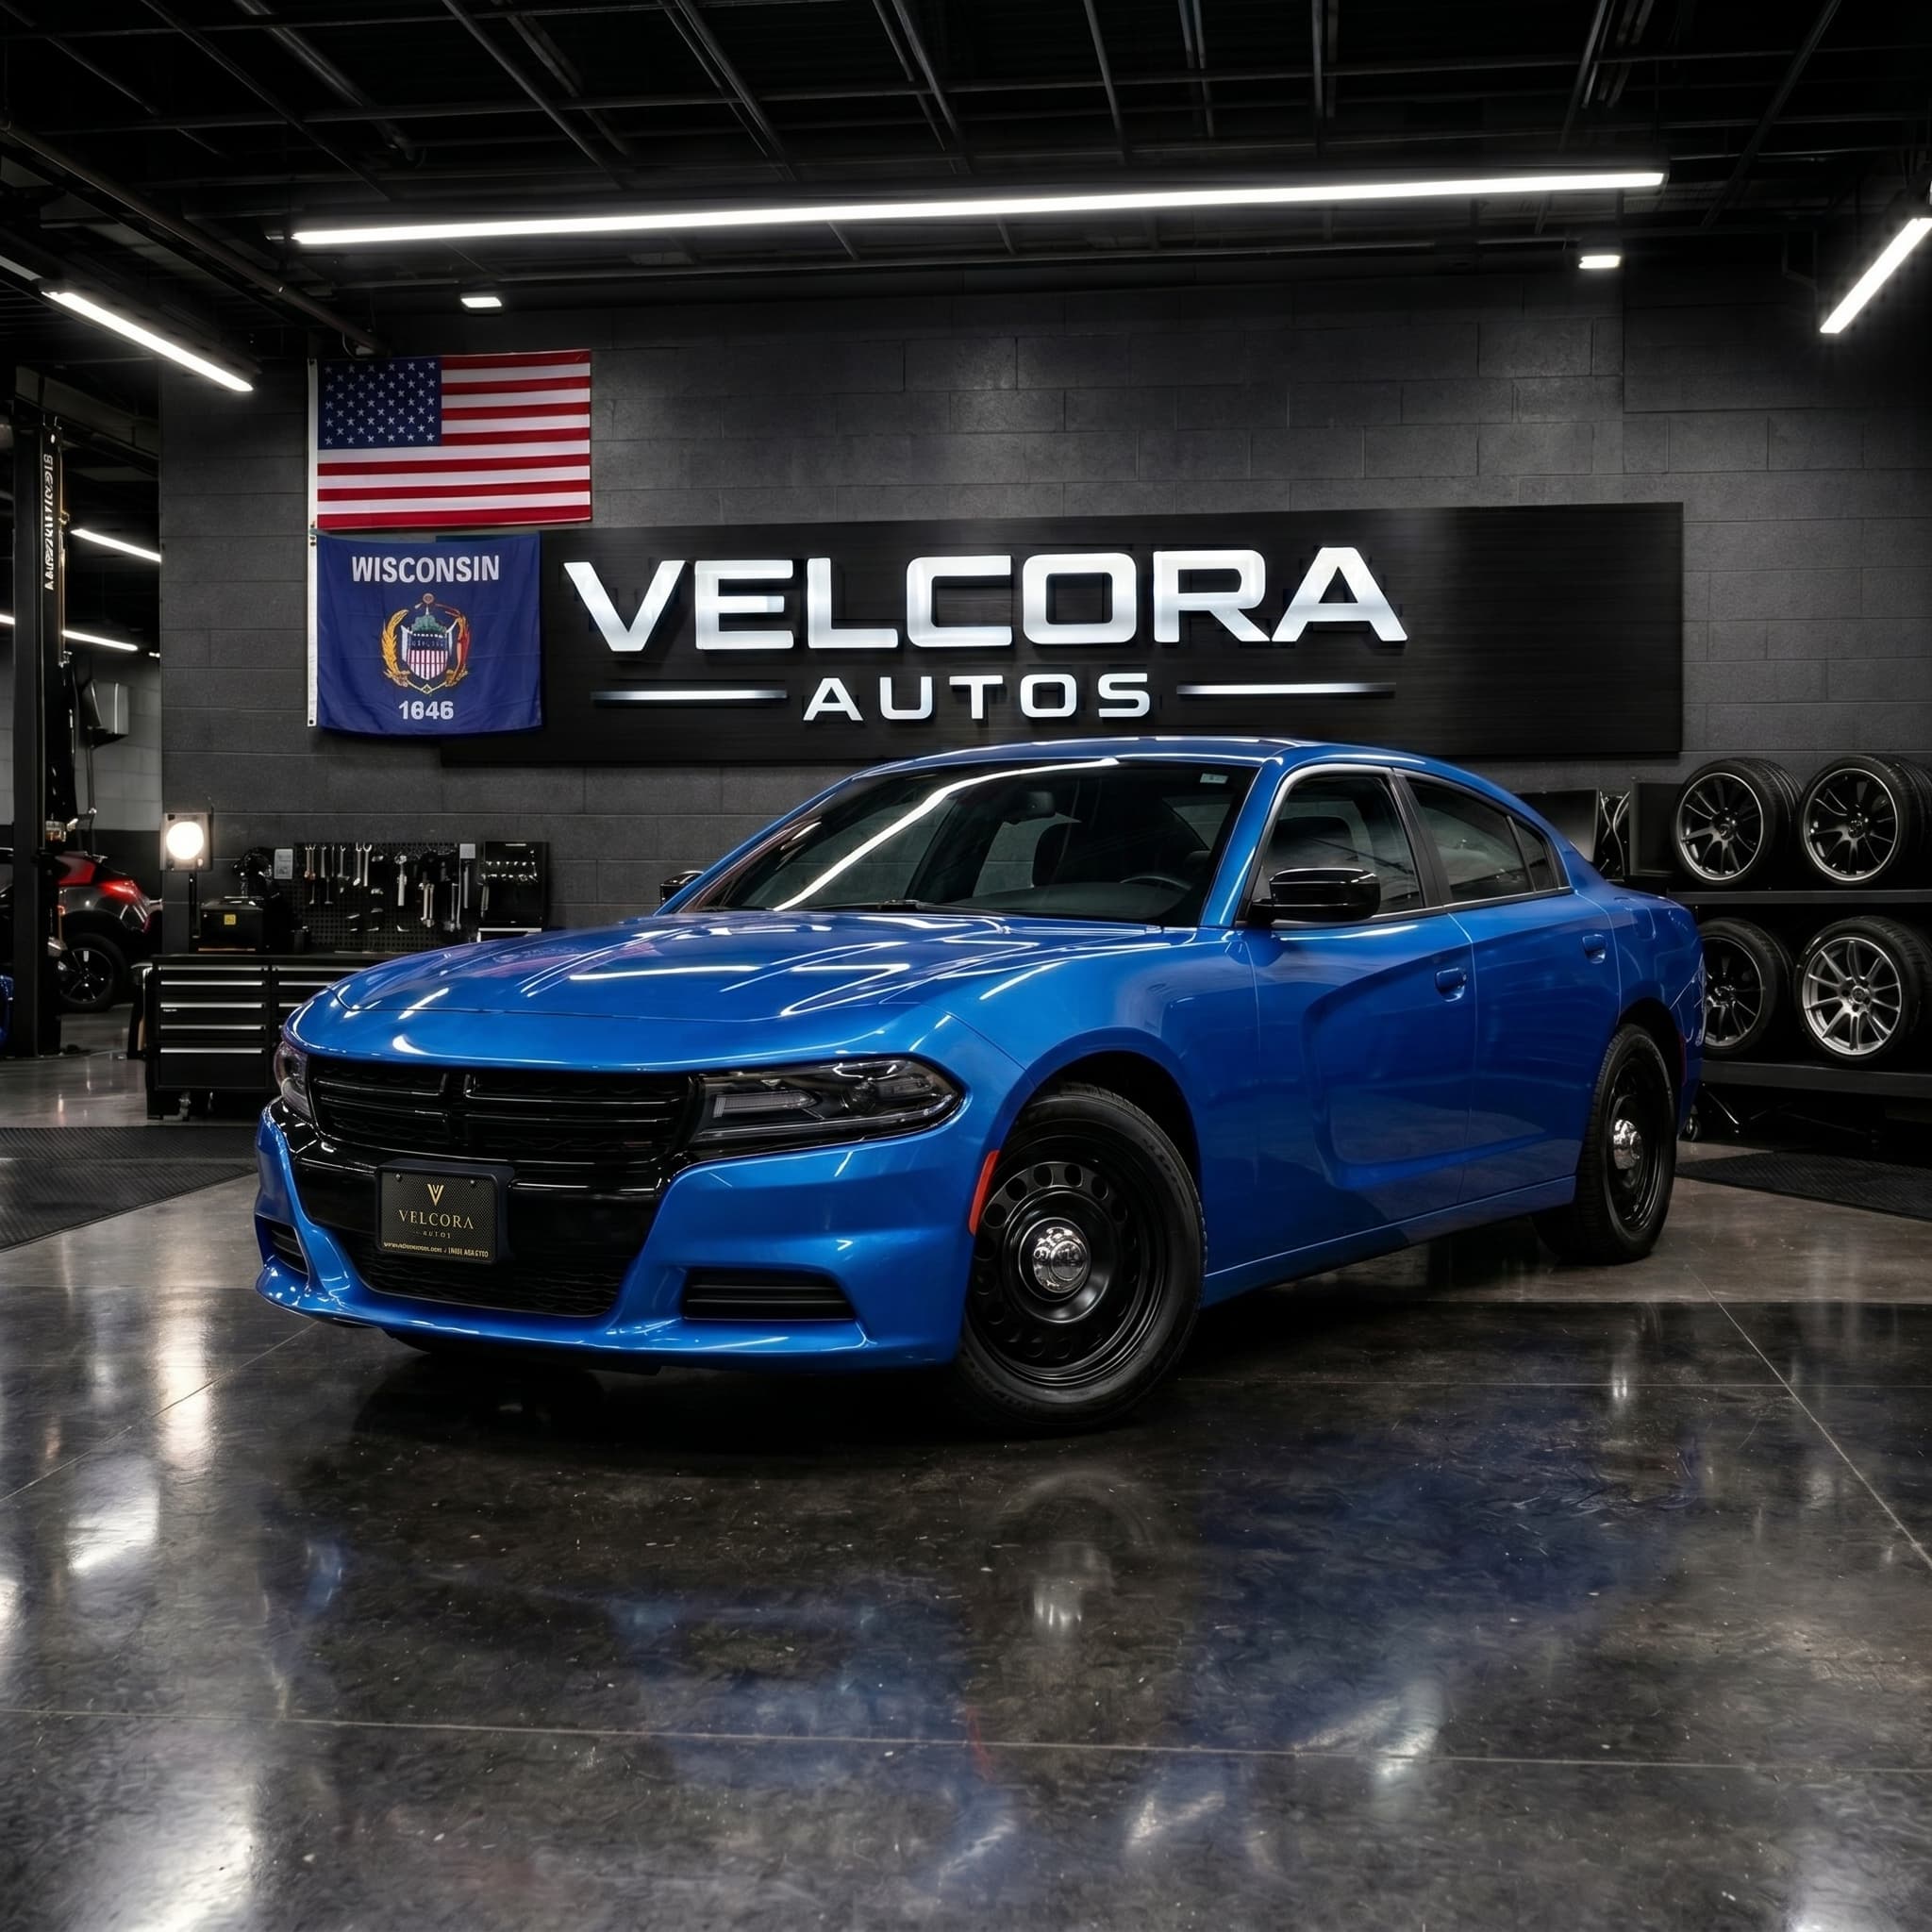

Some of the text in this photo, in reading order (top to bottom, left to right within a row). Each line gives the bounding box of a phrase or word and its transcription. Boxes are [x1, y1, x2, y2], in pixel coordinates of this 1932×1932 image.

[351, 555, 501, 583] WISCONSIN
[563, 546, 1408, 653] VELCORA
[803, 673, 1152, 723] AUTOS
[398, 1209, 474, 1230] VELCORA
